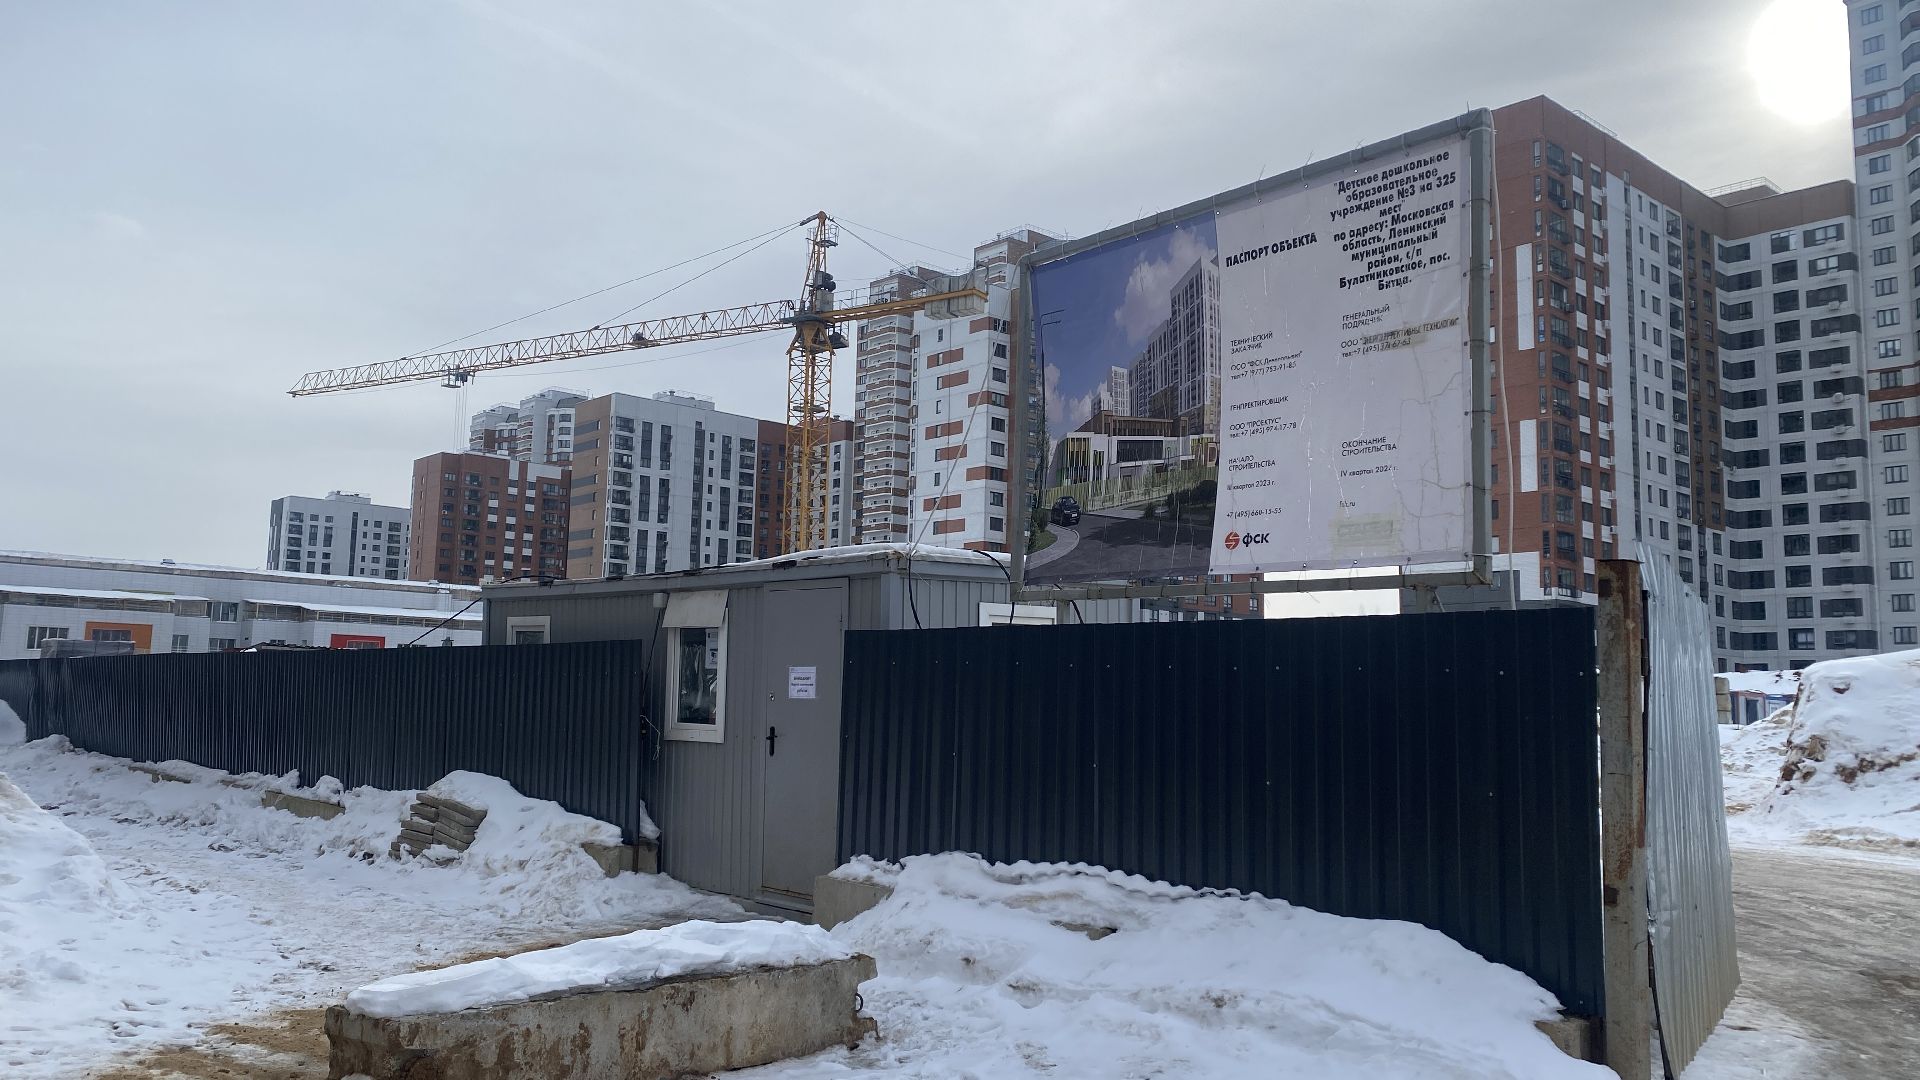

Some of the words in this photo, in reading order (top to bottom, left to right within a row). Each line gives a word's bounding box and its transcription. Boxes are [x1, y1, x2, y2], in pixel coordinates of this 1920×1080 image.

[1381, 152, 1450, 181] дошкольное
[1346, 168, 1438, 202] образовательное
[1330, 193, 1394, 222] учреждение
[1398, 184, 1416, 200] №3
[1420, 182, 1432, 193] на
[1436, 172, 1456, 188] 325
[1380, 200, 1406, 218] мест"
[1334, 232, 1346, 242] по
[1349, 220, 1388, 238] адресу:
[1391, 200, 1454, 226] Московская
[1342, 234, 1386, 252] область,
[1389, 212, 1446, 240] Ленинский
[1226, 245, 1269, 268] ПАСПОРТ
[1272, 232, 1317, 254] ОБЪЕКТА
[1352, 228, 1438, 261] муниципальный
[1367, 254, 1402, 272] район,
[1406, 246, 1422, 261] с/п
[1340, 260, 1426, 289] Булатниковское,
[1430, 252, 1450, 265] пос.
[1378, 276, 1412, 290] Битца.
[1342, 304, 1390, 322] ГЕНЕРАЛЬНЫЙ
[1230, 331, 1272, 347] ТЕХНИЧЕСКИЙ
[1341, 339, 1358, 349] ООО
[1231, 342, 1262, 354] ЗАКАЗЧИК
[1231, 362, 1246, 370] ООО
[1231, 396, 1288, 411] ГЕНПРЕКТИРОВЩИК
[1342, 436, 1386, 449] ОКОНЧАНИЕ
[1342, 443, 1397, 456] СТРОИТЕЛЬСТВА
[1229, 455, 1254, 464] НАЧАЛО
[1229, 460, 1275, 471] СТРОИТЕЛЬСТВА
[1242, 533, 1270, 547] ФСК
